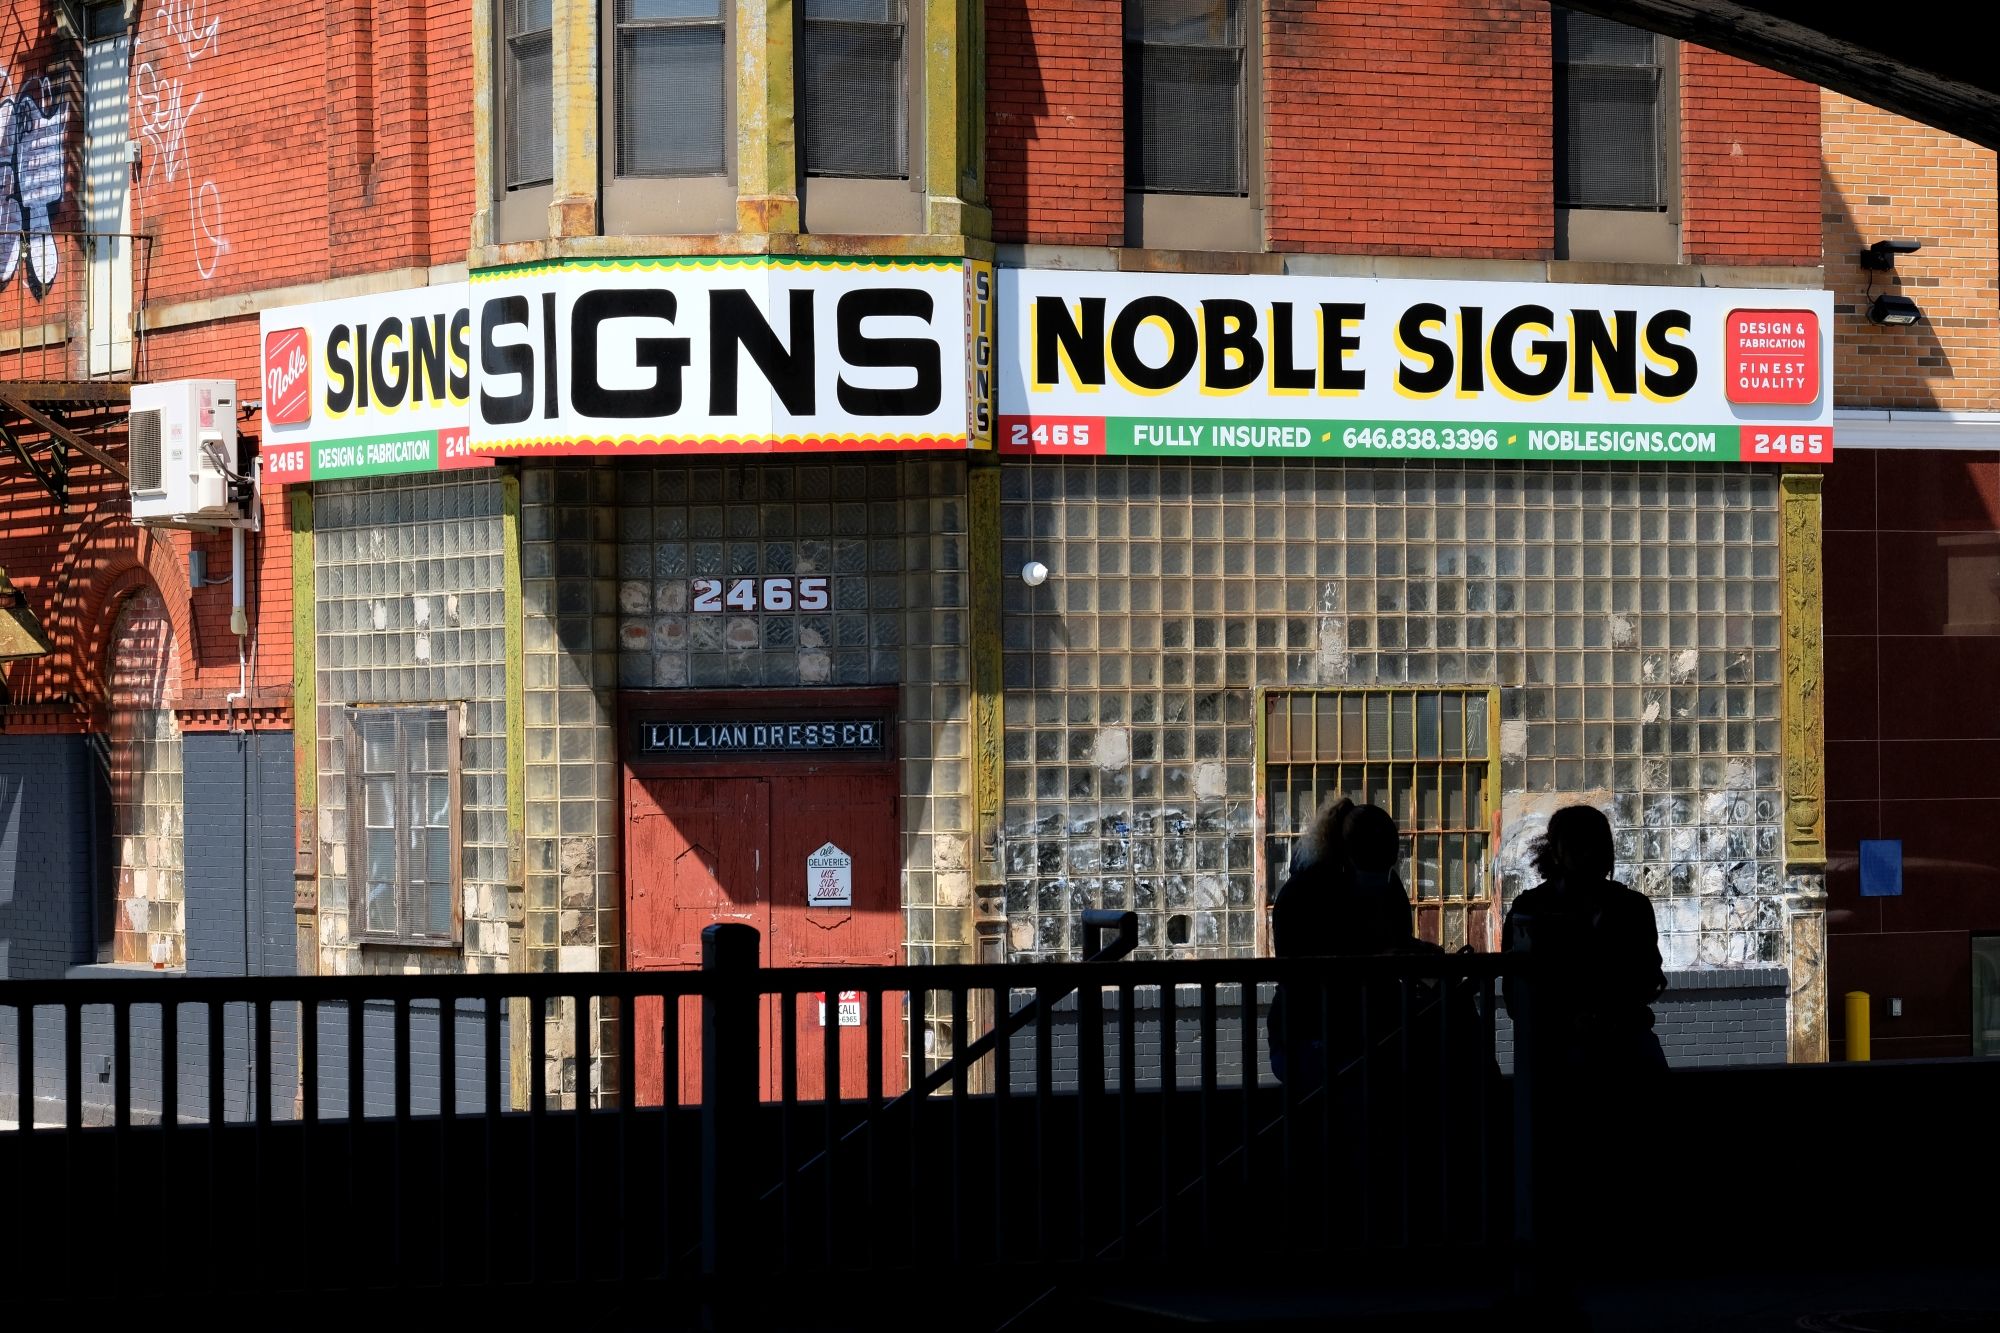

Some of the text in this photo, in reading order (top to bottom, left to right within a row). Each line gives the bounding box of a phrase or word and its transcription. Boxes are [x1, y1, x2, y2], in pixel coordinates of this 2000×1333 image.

[1739, 322, 1805, 334] DESIGN &
[976, 270, 991, 432] SIGNS
[1030, 295, 1698, 404] NOBLE SIGNS
[1739, 338, 1806, 349] FABRICATION
[324, 308, 470, 420] SIGNS
[480, 287, 942, 425] SIGNS
[268, 345, 308, 406] Noble
[1739, 362, 1805, 374] FINEST
[1739, 377, 1806, 389] QUALITY
[1011, 424, 1090, 445] 2465
[1133, 425, 1716, 453] FULLY INSURED 646.838.3396 NOBLESIGNS.COM
[1754, 433, 1823, 454] 2465
[269, 451, 305, 473] 2465
[318, 439, 431, 469] DESIGN & FABRICATION
[693, 578, 828, 612] 2465
[651, 726, 747, 747] LILLIAN
[754, 725, 836, 746] DRESS
[818, 879, 840, 888] SIDE
[820, 869, 837, 879] USE
[817, 886, 845, 897] DOOR!
